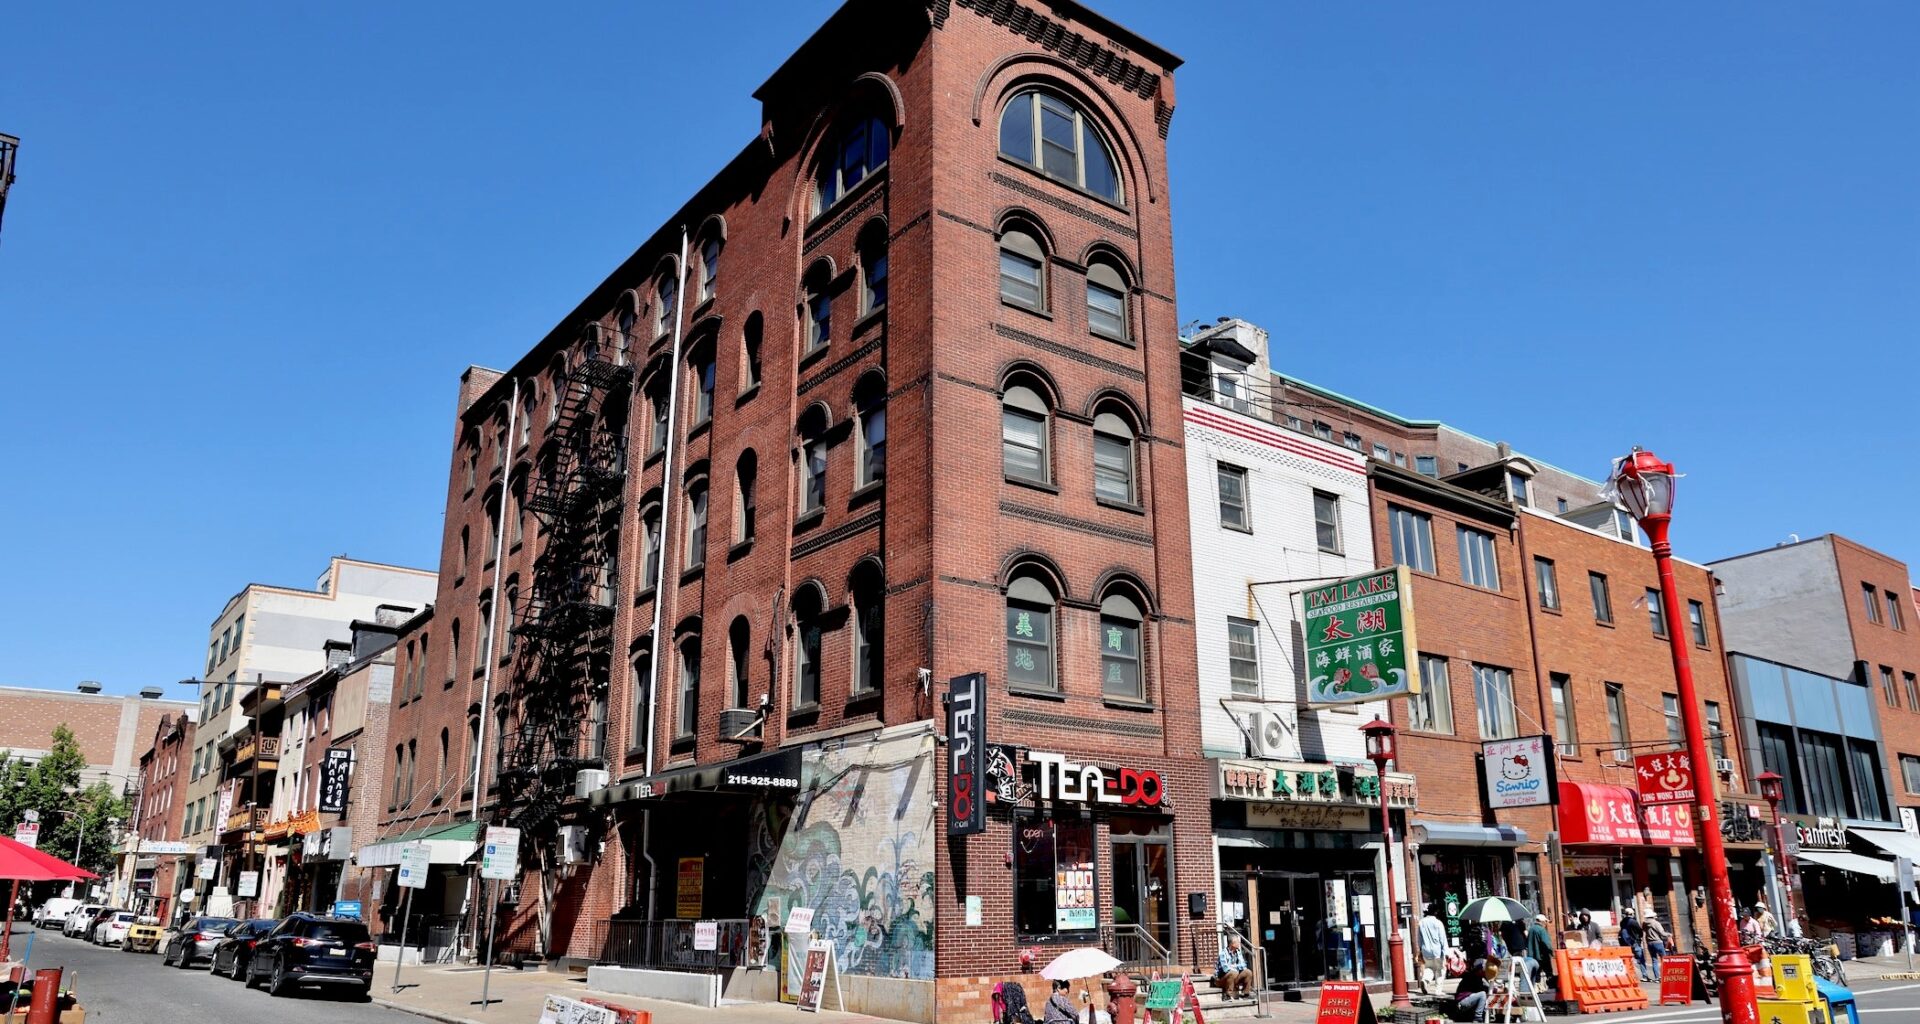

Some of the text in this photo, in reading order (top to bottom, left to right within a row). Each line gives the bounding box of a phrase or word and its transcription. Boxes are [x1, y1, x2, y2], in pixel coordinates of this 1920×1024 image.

[1307, 573, 1396, 608] TAI LAKE
[1309, 592, 1395, 618] SEAFOOD RESTAURANT
[1320, 607, 1387, 642] 太湖
[1315, 638, 1396, 668] 海鮮酒家
[953, 679, 976, 821] TEA-DO
[1638, 754, 1691, 780] 天旺大飯
[728, 774, 799, 788] 215-925-8889
[1028, 751, 1162, 805] TEA-DO
[1496, 778, 1539, 793] Sanrio
[1641, 793, 1656, 802] TING
[1656, 791, 1674, 801] WONG
[1023, 829, 1044, 839] open
[1586, 961, 1624, 973] NO PARKING
[1328, 998, 1352, 1006] FIRE
[1321, 1008, 1356, 1017] HOUSE
